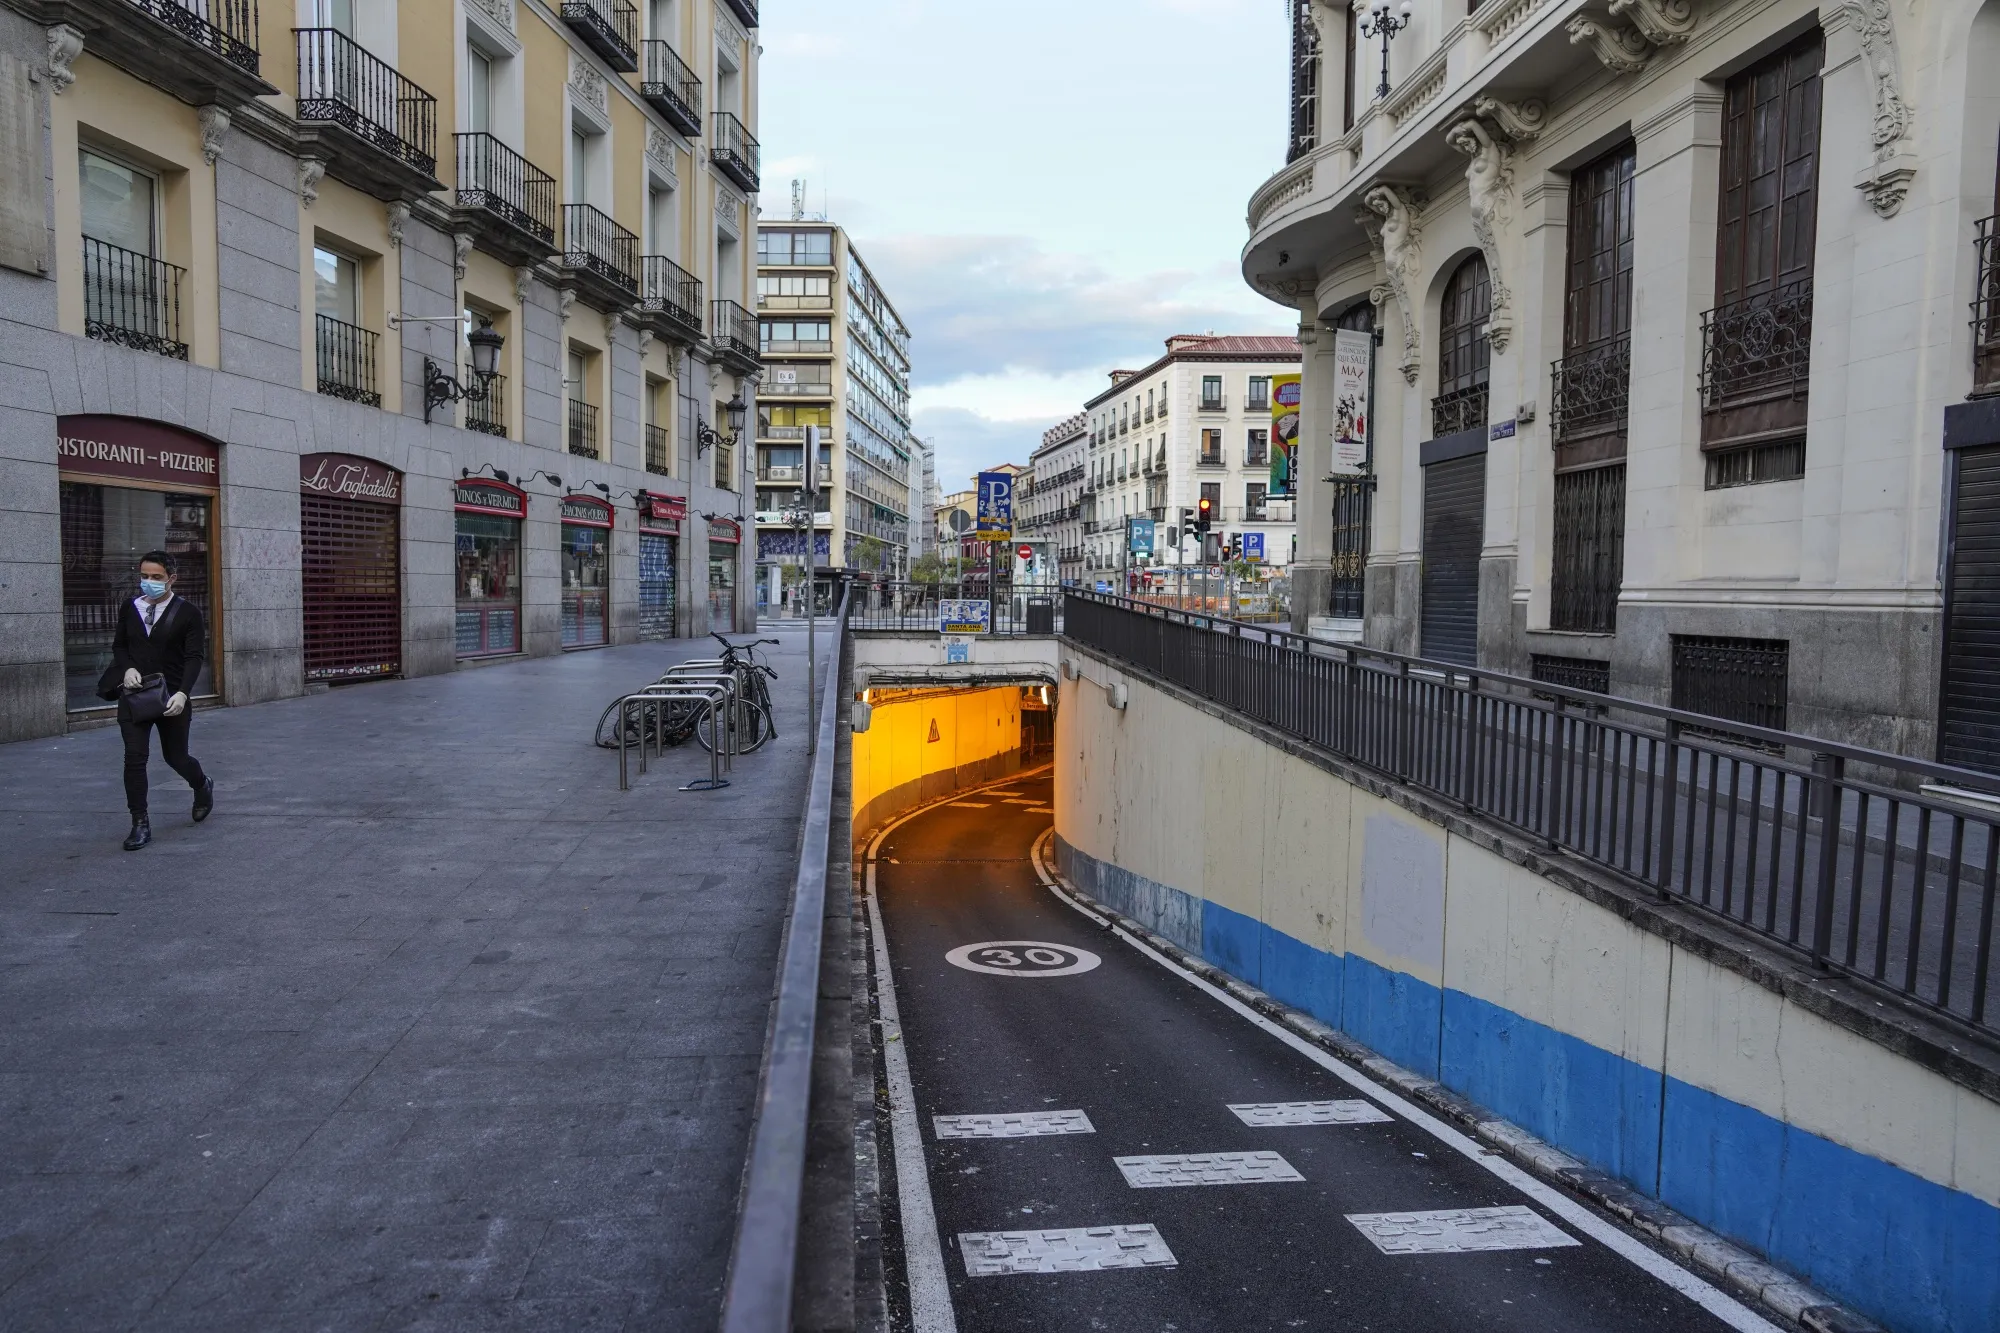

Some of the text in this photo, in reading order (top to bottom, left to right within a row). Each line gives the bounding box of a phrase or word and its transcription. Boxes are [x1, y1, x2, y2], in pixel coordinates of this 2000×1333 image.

[1343, 346, 1367, 356] FUNCIÓN
[1337, 354, 1367, 365] QUE SALE
[1341, 364, 1364, 381] MAL
[1281, 384, 1300, 394] ADIÓS
[1278, 393, 1300, 403] ARTUR
[160, 451, 216, 474] PIZZERIE
[300, 458, 398, 500] La Tagliatella
[456, 489, 482, 505] VINOS
[487, 493, 520, 510] VERMUT
[986, 481, 1009, 503] P
[1133, 526, 1143, 540] P
[1248, 535, 1259, 547] P
[980, 948, 1066, 967] 30
